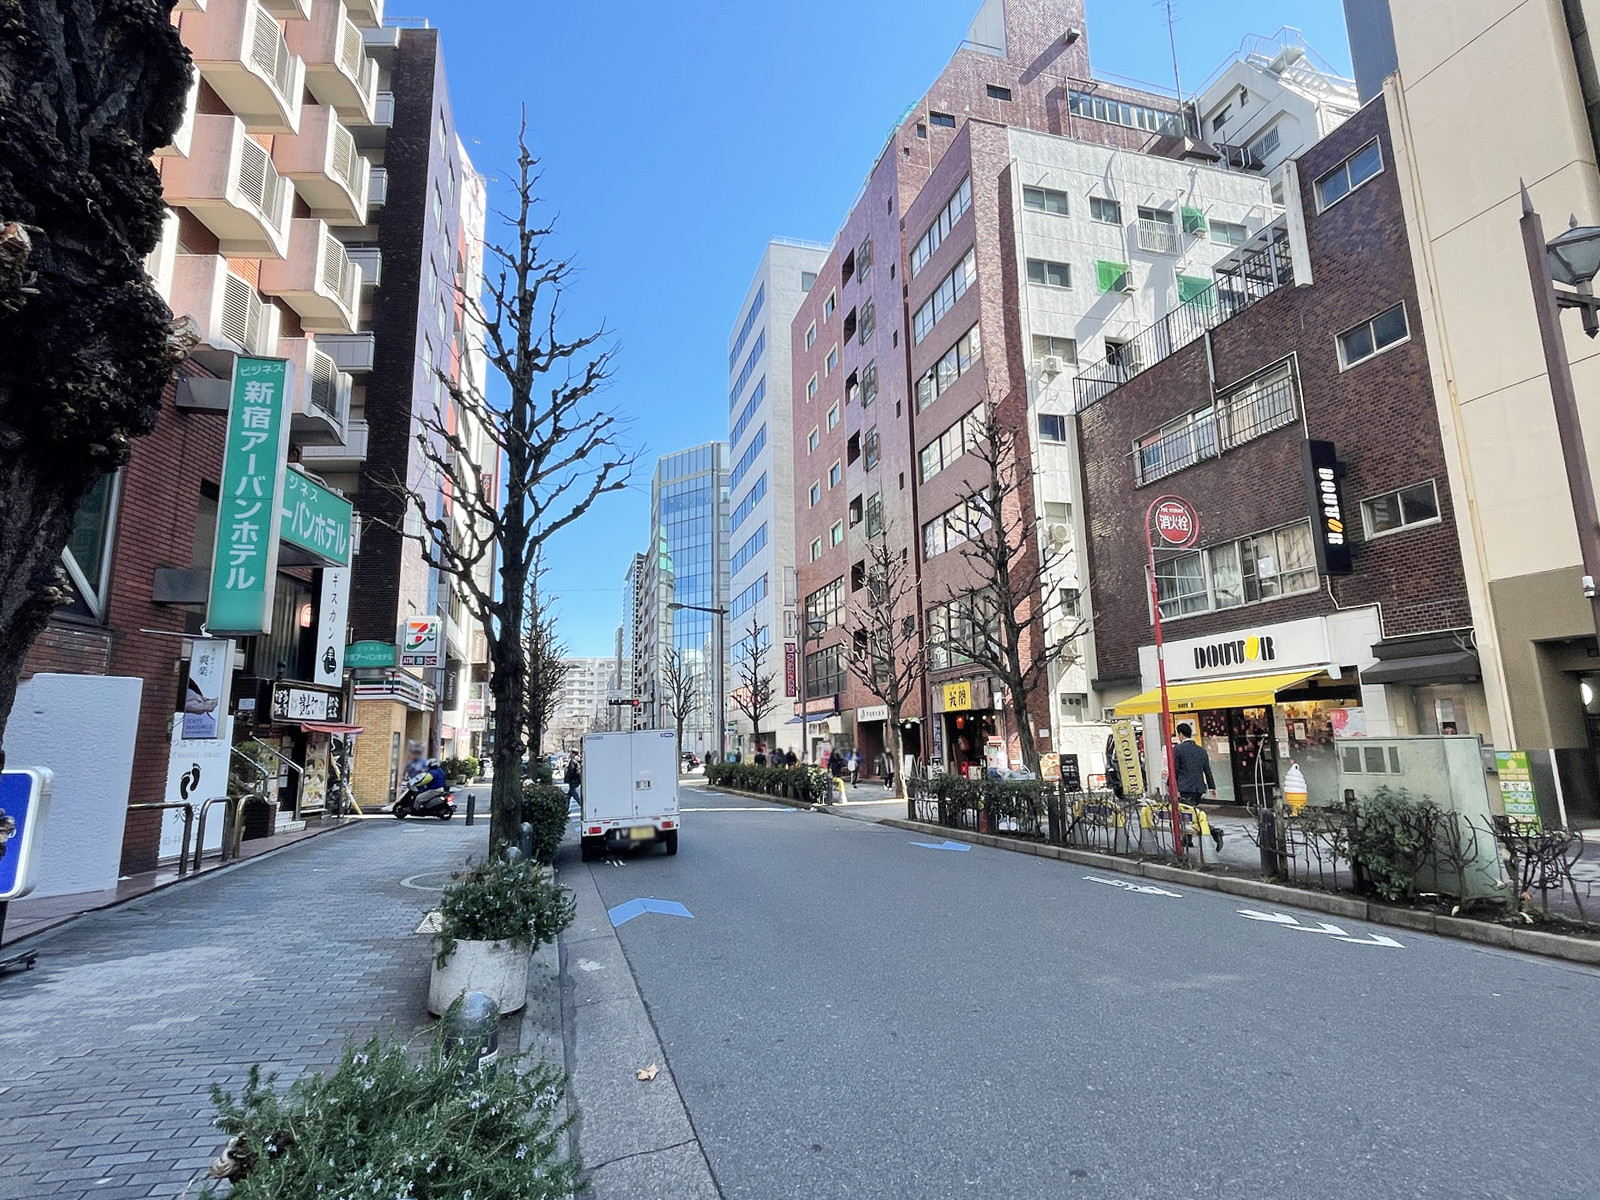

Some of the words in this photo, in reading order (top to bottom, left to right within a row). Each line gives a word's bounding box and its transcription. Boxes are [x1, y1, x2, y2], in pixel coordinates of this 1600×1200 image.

[240, 364, 284, 376] ビジネス
[225, 380, 274, 590] 新宿アーバンホテル
[1159, 514, 1189, 532] 消火栓
[1319, 467, 1343, 545] DOUTOR
[1193, 634, 1275, 669] DOUTOR
